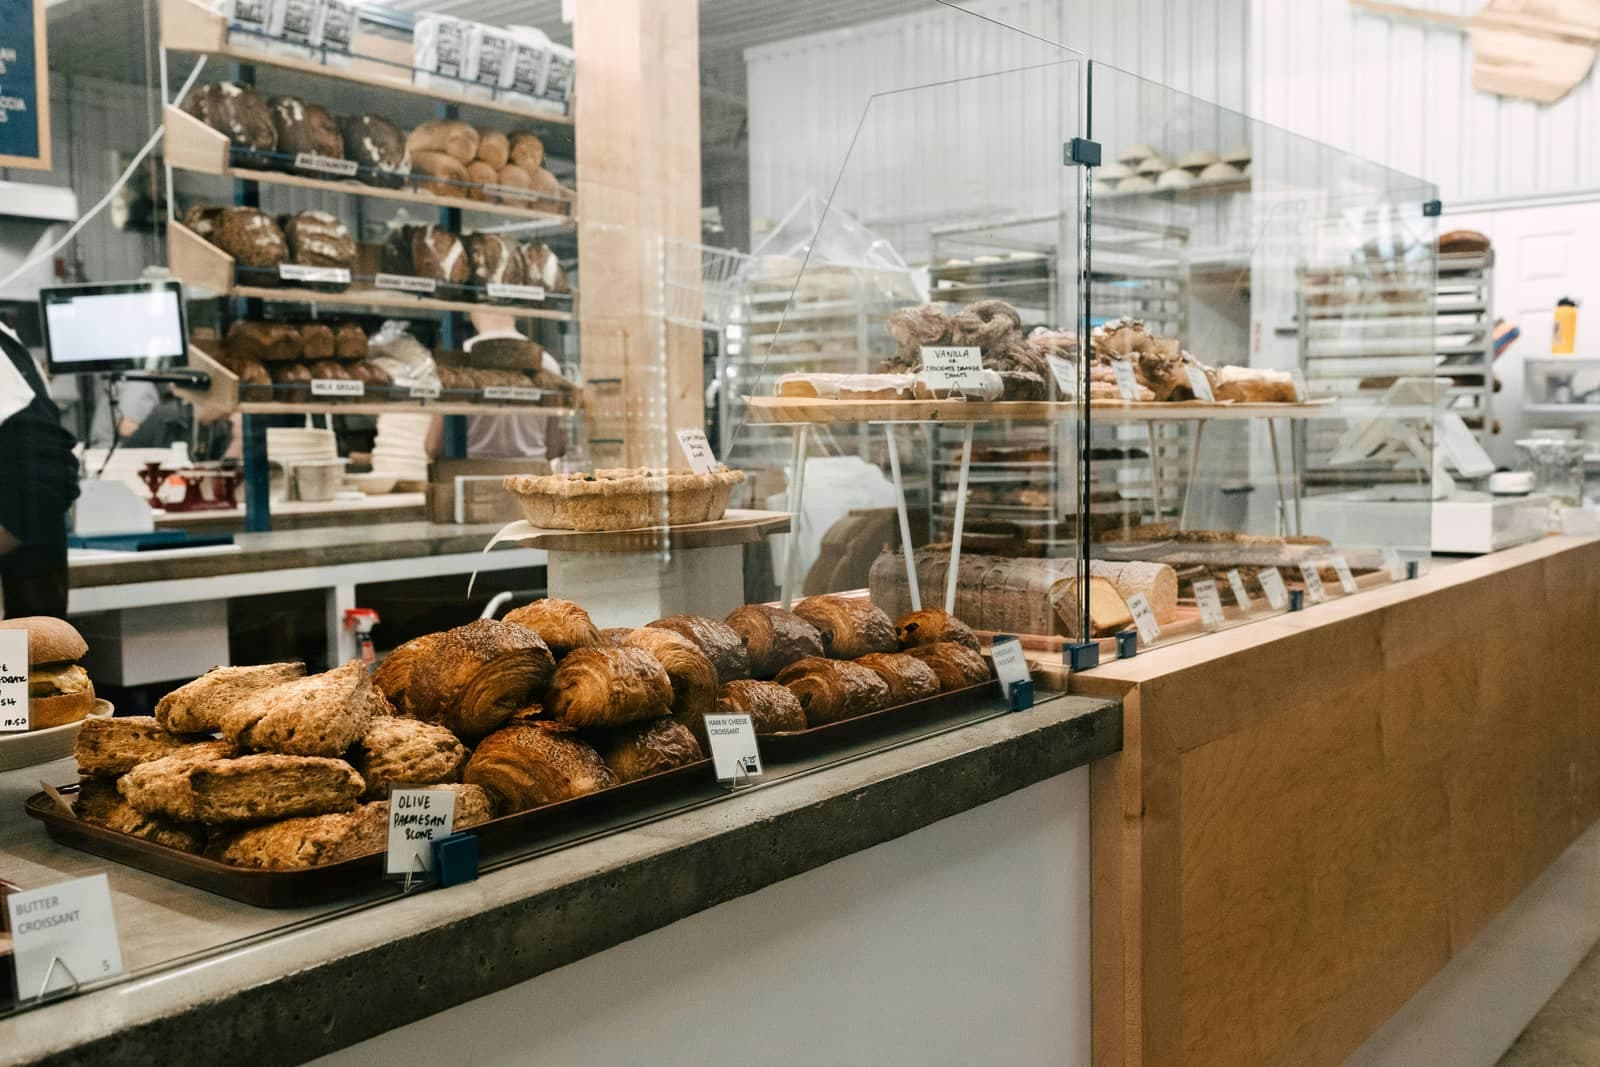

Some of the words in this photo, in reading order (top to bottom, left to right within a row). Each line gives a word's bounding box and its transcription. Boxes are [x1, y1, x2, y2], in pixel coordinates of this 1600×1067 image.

[934, 349, 969, 359] VANILLA
[710, 727, 740, 736] CROISSANT
[398, 795, 431, 809] OLIVE
[393, 813, 448, 828] PARMESAN
[405, 828, 433, 841] SCONE
[15, 895, 60, 916] BUTTER
[17, 909, 81, 935] CROISSANT
